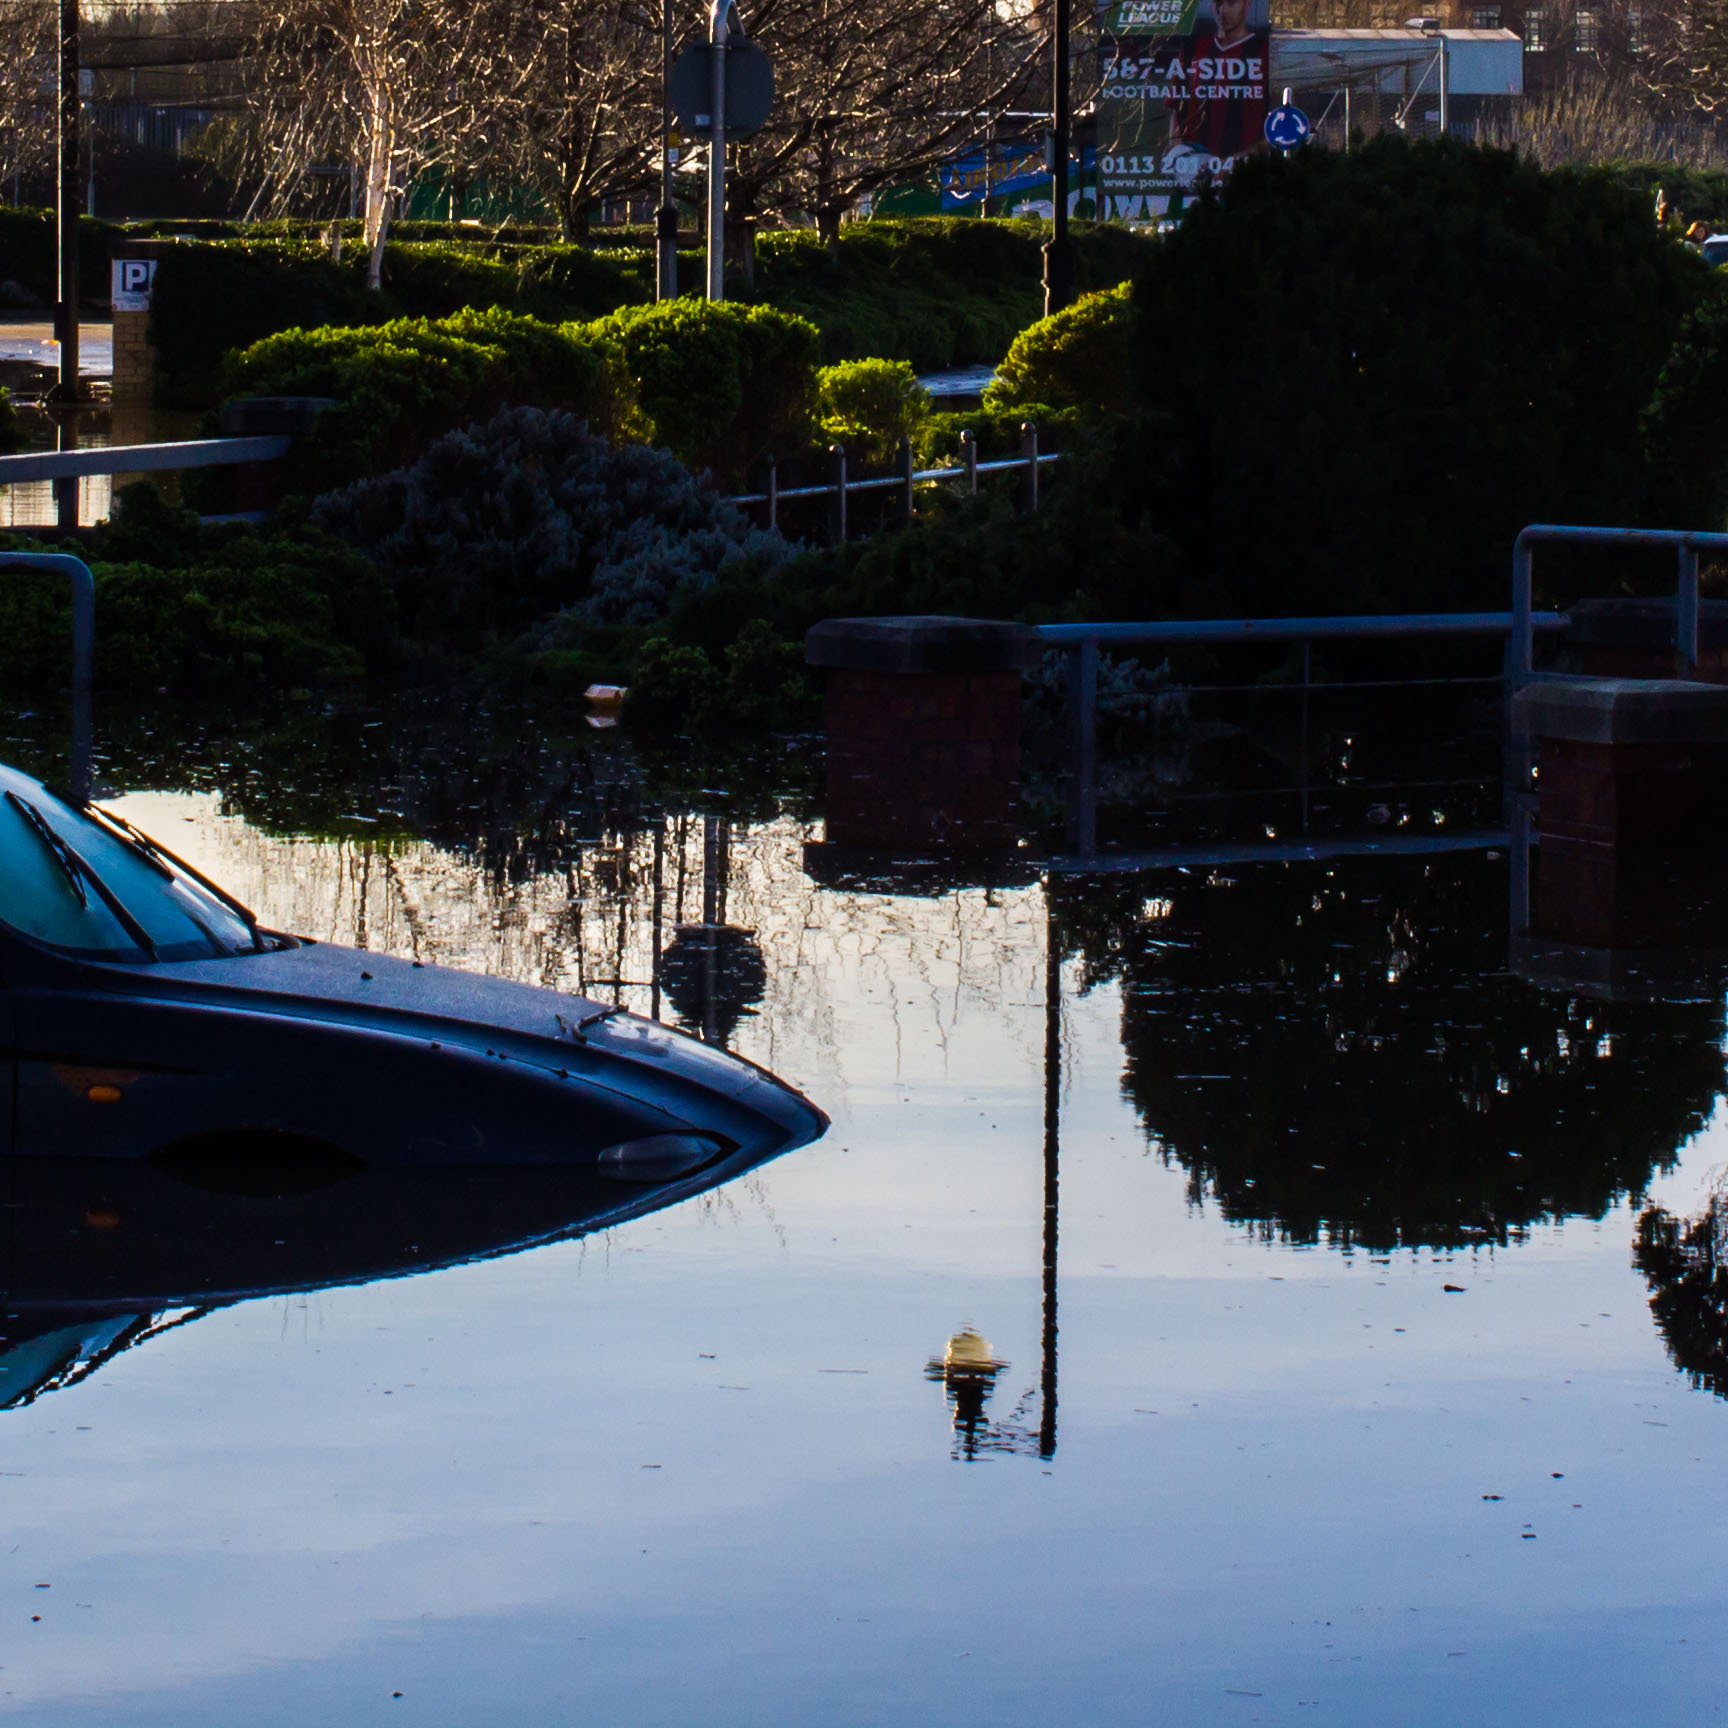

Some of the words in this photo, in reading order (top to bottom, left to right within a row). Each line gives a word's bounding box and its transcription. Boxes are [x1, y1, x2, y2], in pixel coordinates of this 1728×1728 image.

[1122, 0, 1184, 12] POWER
[1118, 11, 1182, 24] LEAGUE
[1103, 57, 1263, 81] 5&7-A-SIDE
[1195, 85, 1263, 99] CENTRE
[1101, 156, 1155, 174] 0113
[125, 263, 147, 291] P
